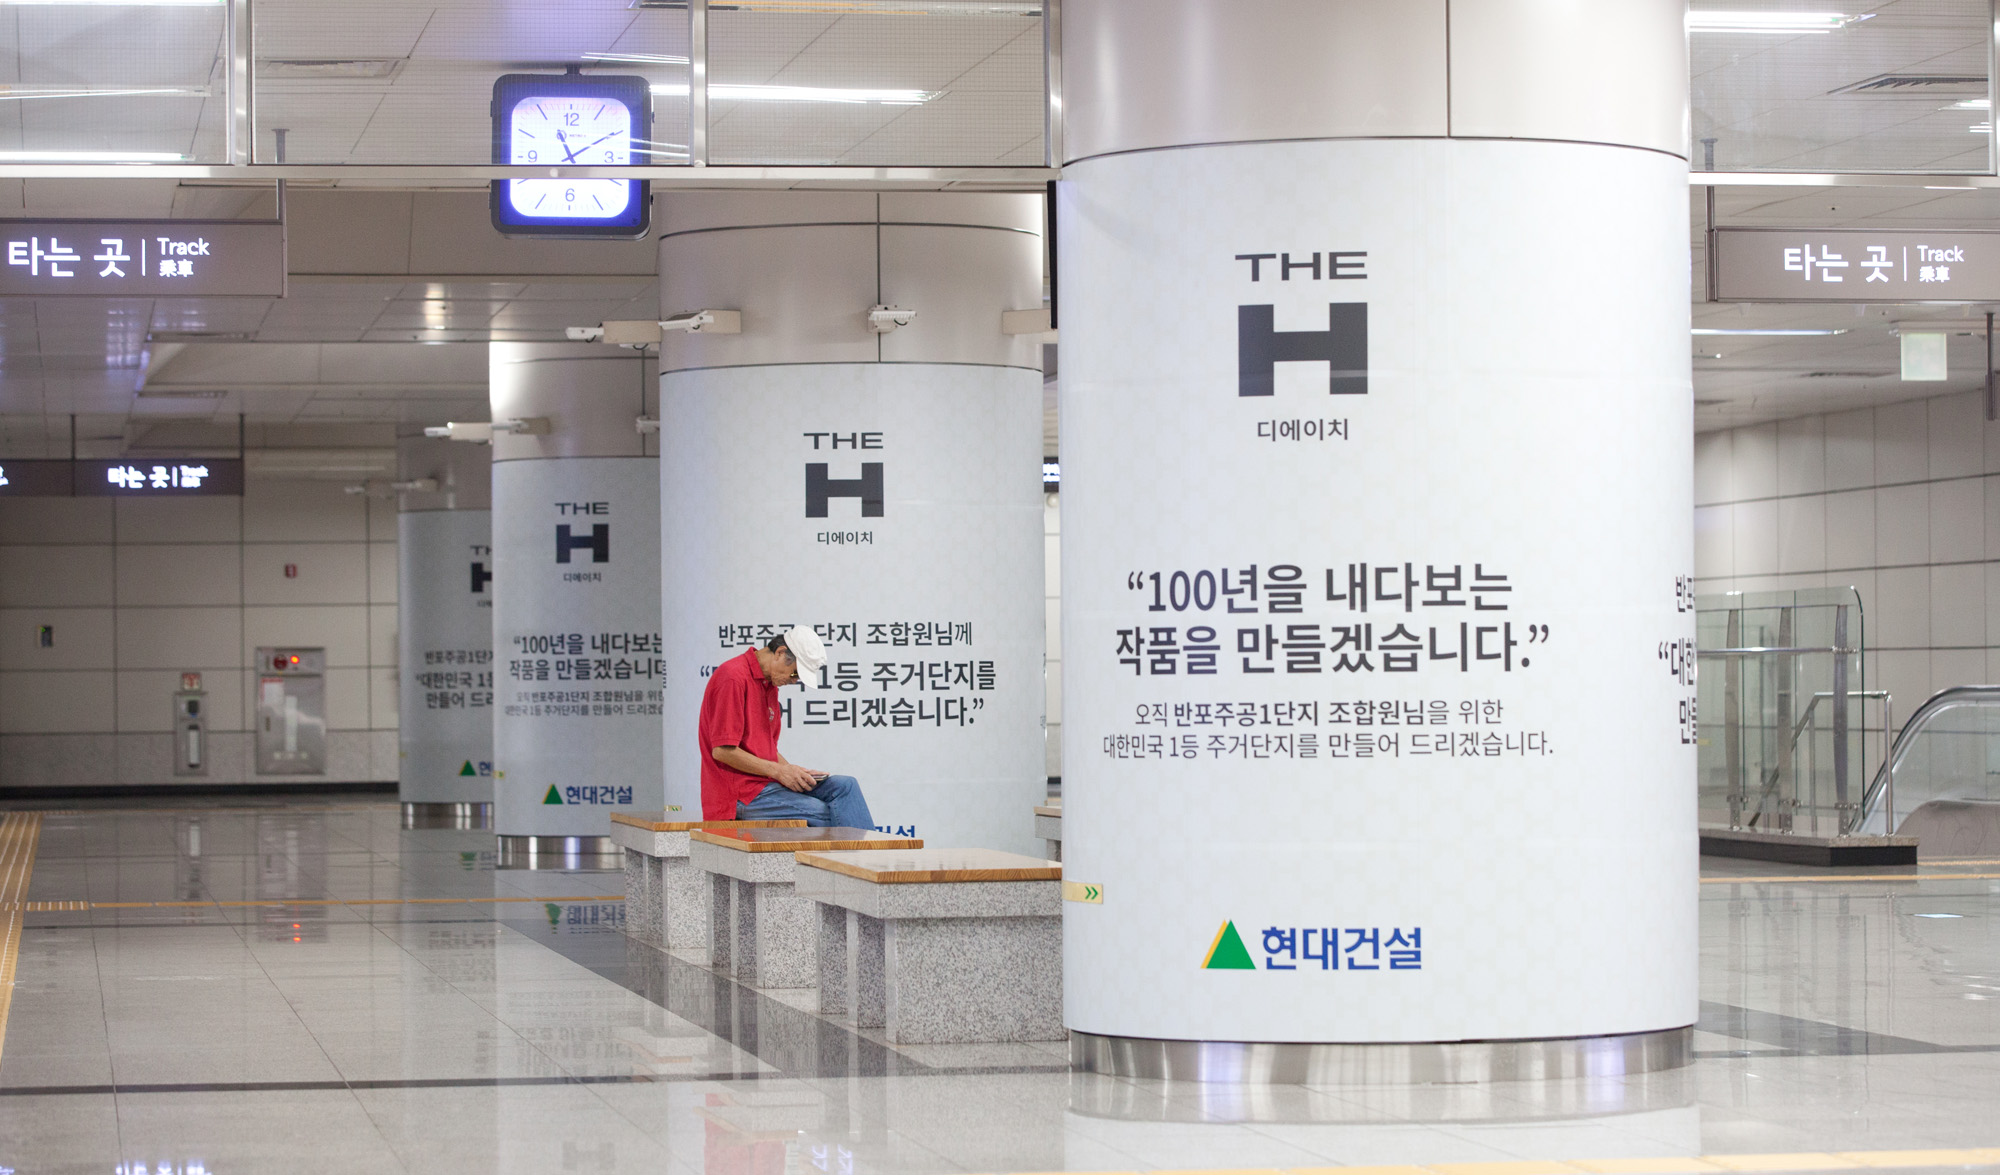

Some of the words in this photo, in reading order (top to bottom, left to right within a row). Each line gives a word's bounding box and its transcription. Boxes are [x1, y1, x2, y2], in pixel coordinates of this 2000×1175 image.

[564, 113, 579, 126] 12
[528, 150, 538, 163] 9
[604, 151, 614, 163] 3
[565, 188, 575, 202] 6
[8, 236, 81, 277] 타는
[93, 238, 131, 278] 곳
[157, 237, 210, 257] Track
[1917, 245, 1964, 262] Track
[1235, 251, 1368, 282] THE
[1784, 244, 1849, 282] 타는
[1860, 246, 1893, 283] 곳
[1238, 302, 1368, 397] H
[803, 432, 884, 449] THE
[1257, 418, 1349, 442] 디에이치
[107, 466, 146, 489] 타는
[149, 466, 170, 489] 곳
[805, 463, 885, 518] H
[555, 502, 609, 515] THE
[556, 524, 609, 563] H
[817, 531, 873, 545] 디에이치
[563, 572, 602, 582] 디에이치
[1127, 563, 1307, 615] “100년을
[1325, 561, 1513, 613] 내다보는
[514, 633, 585, 655] “100년을
[719, 622, 857, 648] 반포주단지
[866, 621, 973, 647] 조합원님께
[1115, 624, 1221, 676] 작품을
[1237, 620, 1550, 675] 만들겠습니다.”
[510, 659, 550, 681] 작품을
[871, 660, 997, 692] 주거단지를
[803, 696, 985, 729] 드리겠습니다.”
[1135, 702, 1168, 727] 오직
[1174, 701, 1319, 727] 반포주공1단지
[1328, 699, 1450, 726] 조합원님을
[1458, 699, 1504, 725] 위한
[1104, 734, 1164, 759] 대한민국
[1170, 734, 1199, 759] 1등
[1206, 733, 1320, 759] 주거단지를
[1329, 732, 1399, 758] 만들어
[1409, 730, 1554, 758] 드리겠습니다.
[566, 785, 633, 805] 현대건설
[1262, 926, 1422, 970] 현대건설
